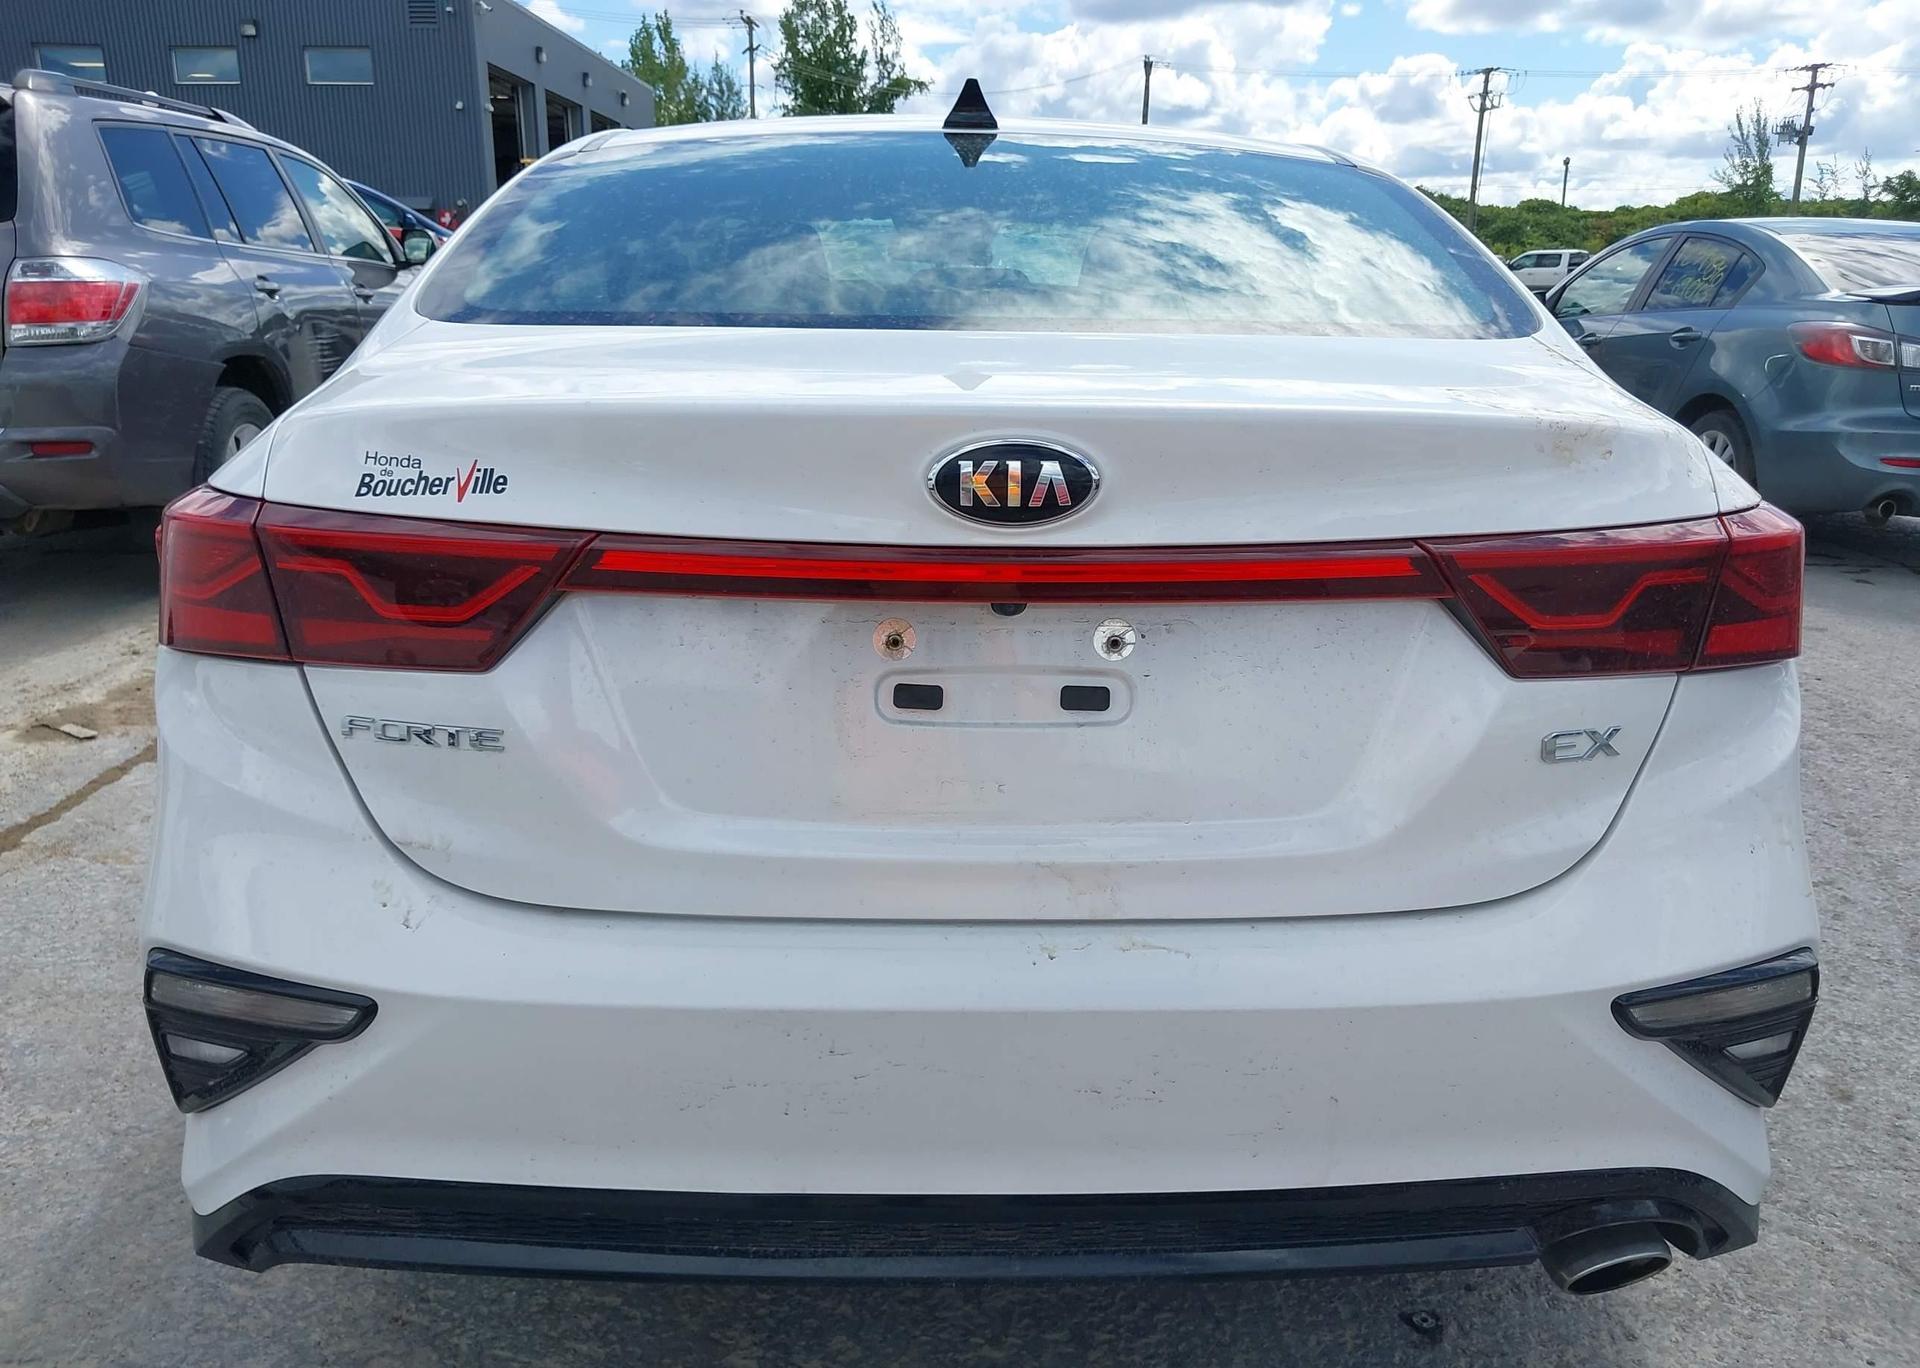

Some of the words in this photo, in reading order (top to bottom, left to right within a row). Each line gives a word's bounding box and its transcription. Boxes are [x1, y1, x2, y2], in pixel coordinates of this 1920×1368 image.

[364, 450, 422, 469] Honda
[379, 467, 394, 477] de
[355, 459, 508, 502] BoucherVille
[957, 460, 1072, 507] KIA
[341, 715, 505, 752] FORTE
[1540, 726, 1622, 764] EX
